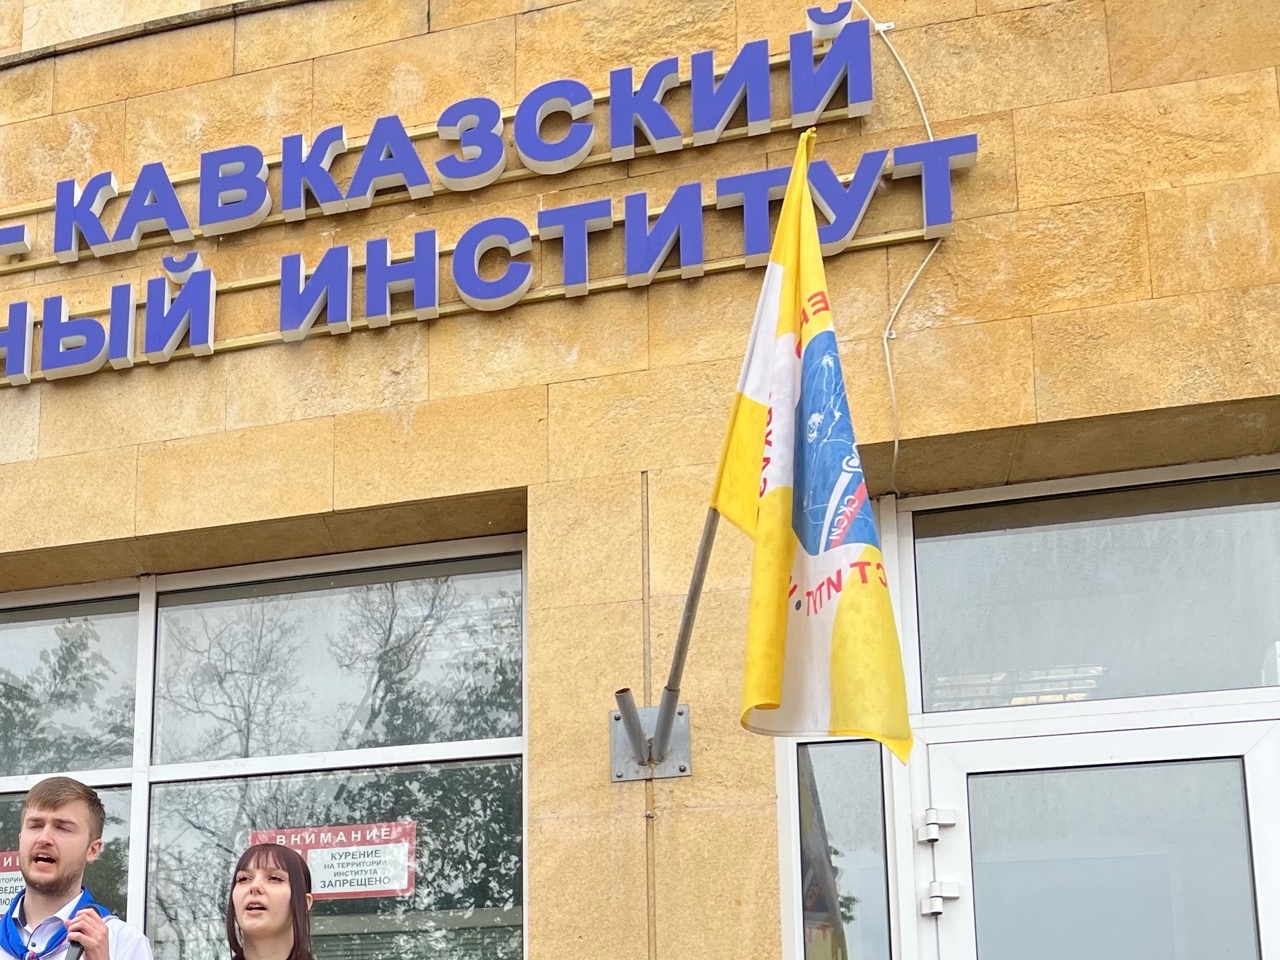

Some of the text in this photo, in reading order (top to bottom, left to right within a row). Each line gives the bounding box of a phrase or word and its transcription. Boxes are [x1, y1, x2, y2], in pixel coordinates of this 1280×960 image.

[54, 2, 872, 253] КАВКАЗСКИЙ
[280, 133, 978, 330] ИНСТИТУТ
[276, 828, 391, 846] ВНИМАНИЕ
[330, 849, 381, 861] КУРЕНИЕ
[337, 860, 387, 869] ТЕРРИТОРИИ
[333, 869, 378, 877] ИНСТИТУТА
[320, 876, 391, 889] ЗАПРЕЩЕНО
